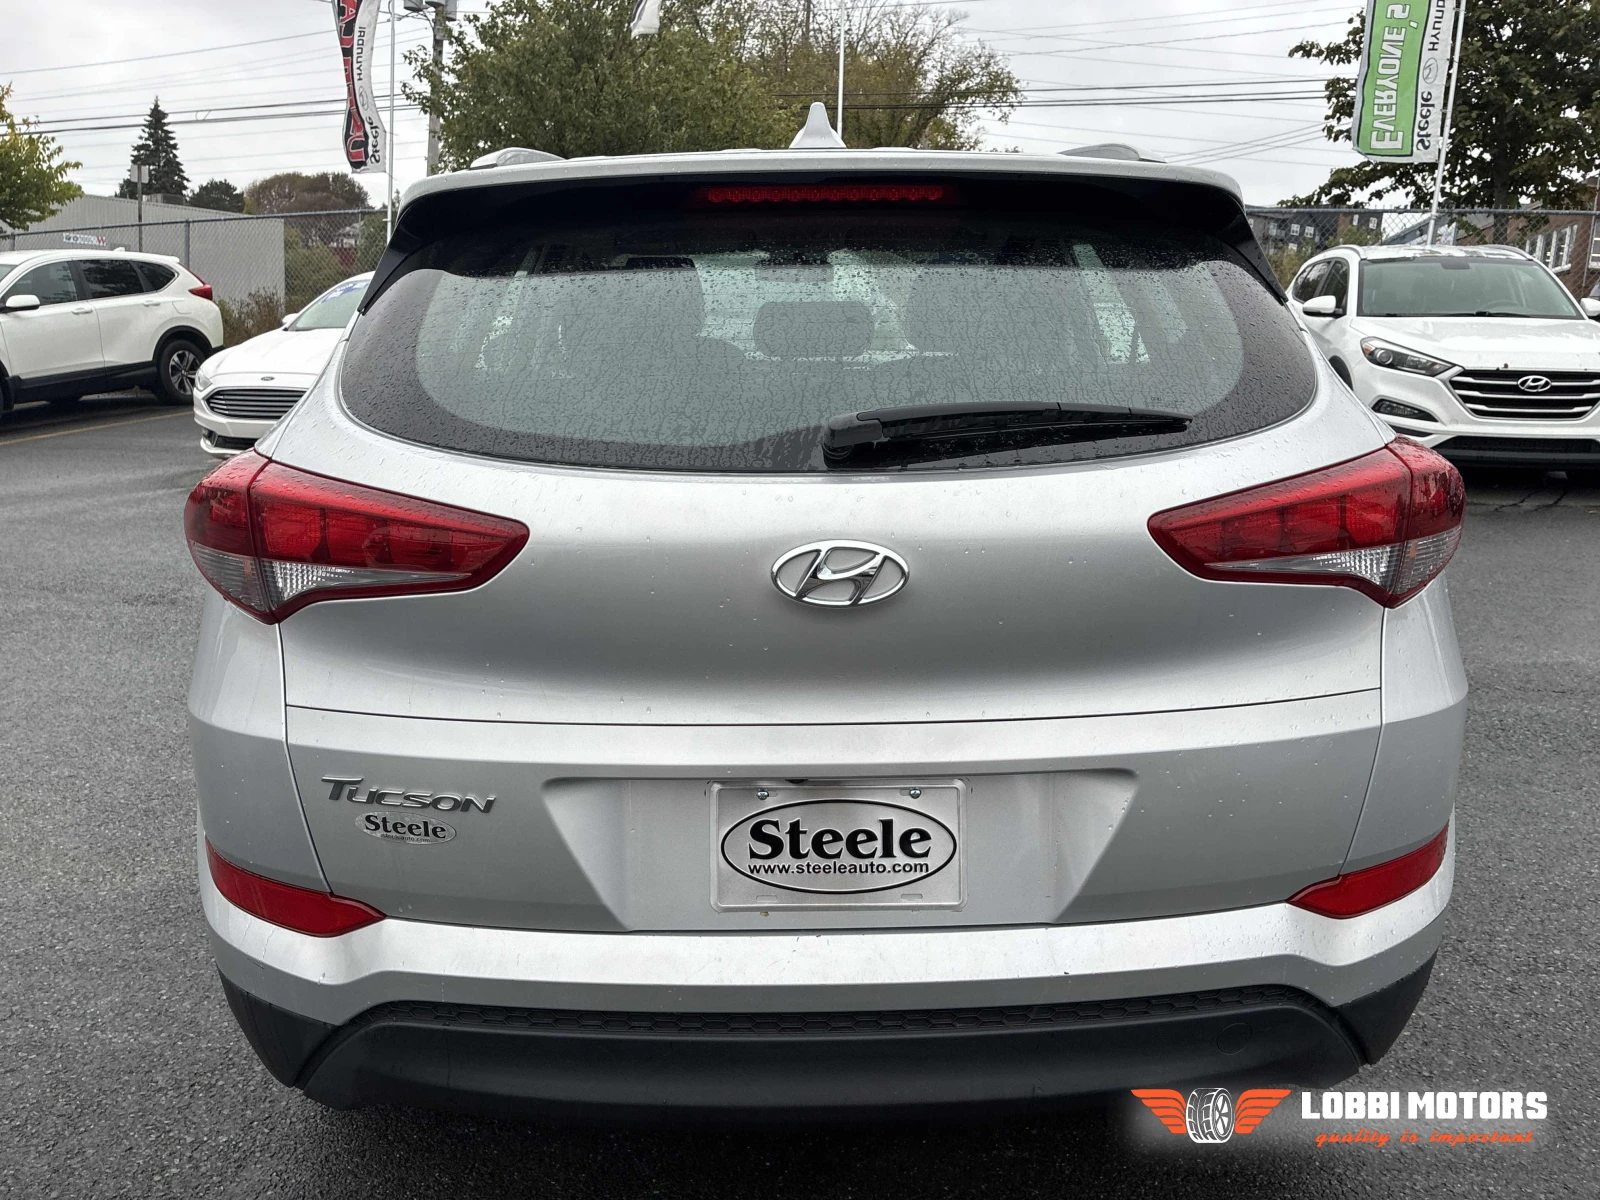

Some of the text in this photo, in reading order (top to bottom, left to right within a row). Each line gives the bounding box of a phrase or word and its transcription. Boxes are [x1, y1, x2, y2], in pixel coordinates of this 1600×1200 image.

[364, 814, 447, 840] Steele
[748, 818, 932, 860] Steele
[748, 861, 930, 875] www.steeleauto.com
